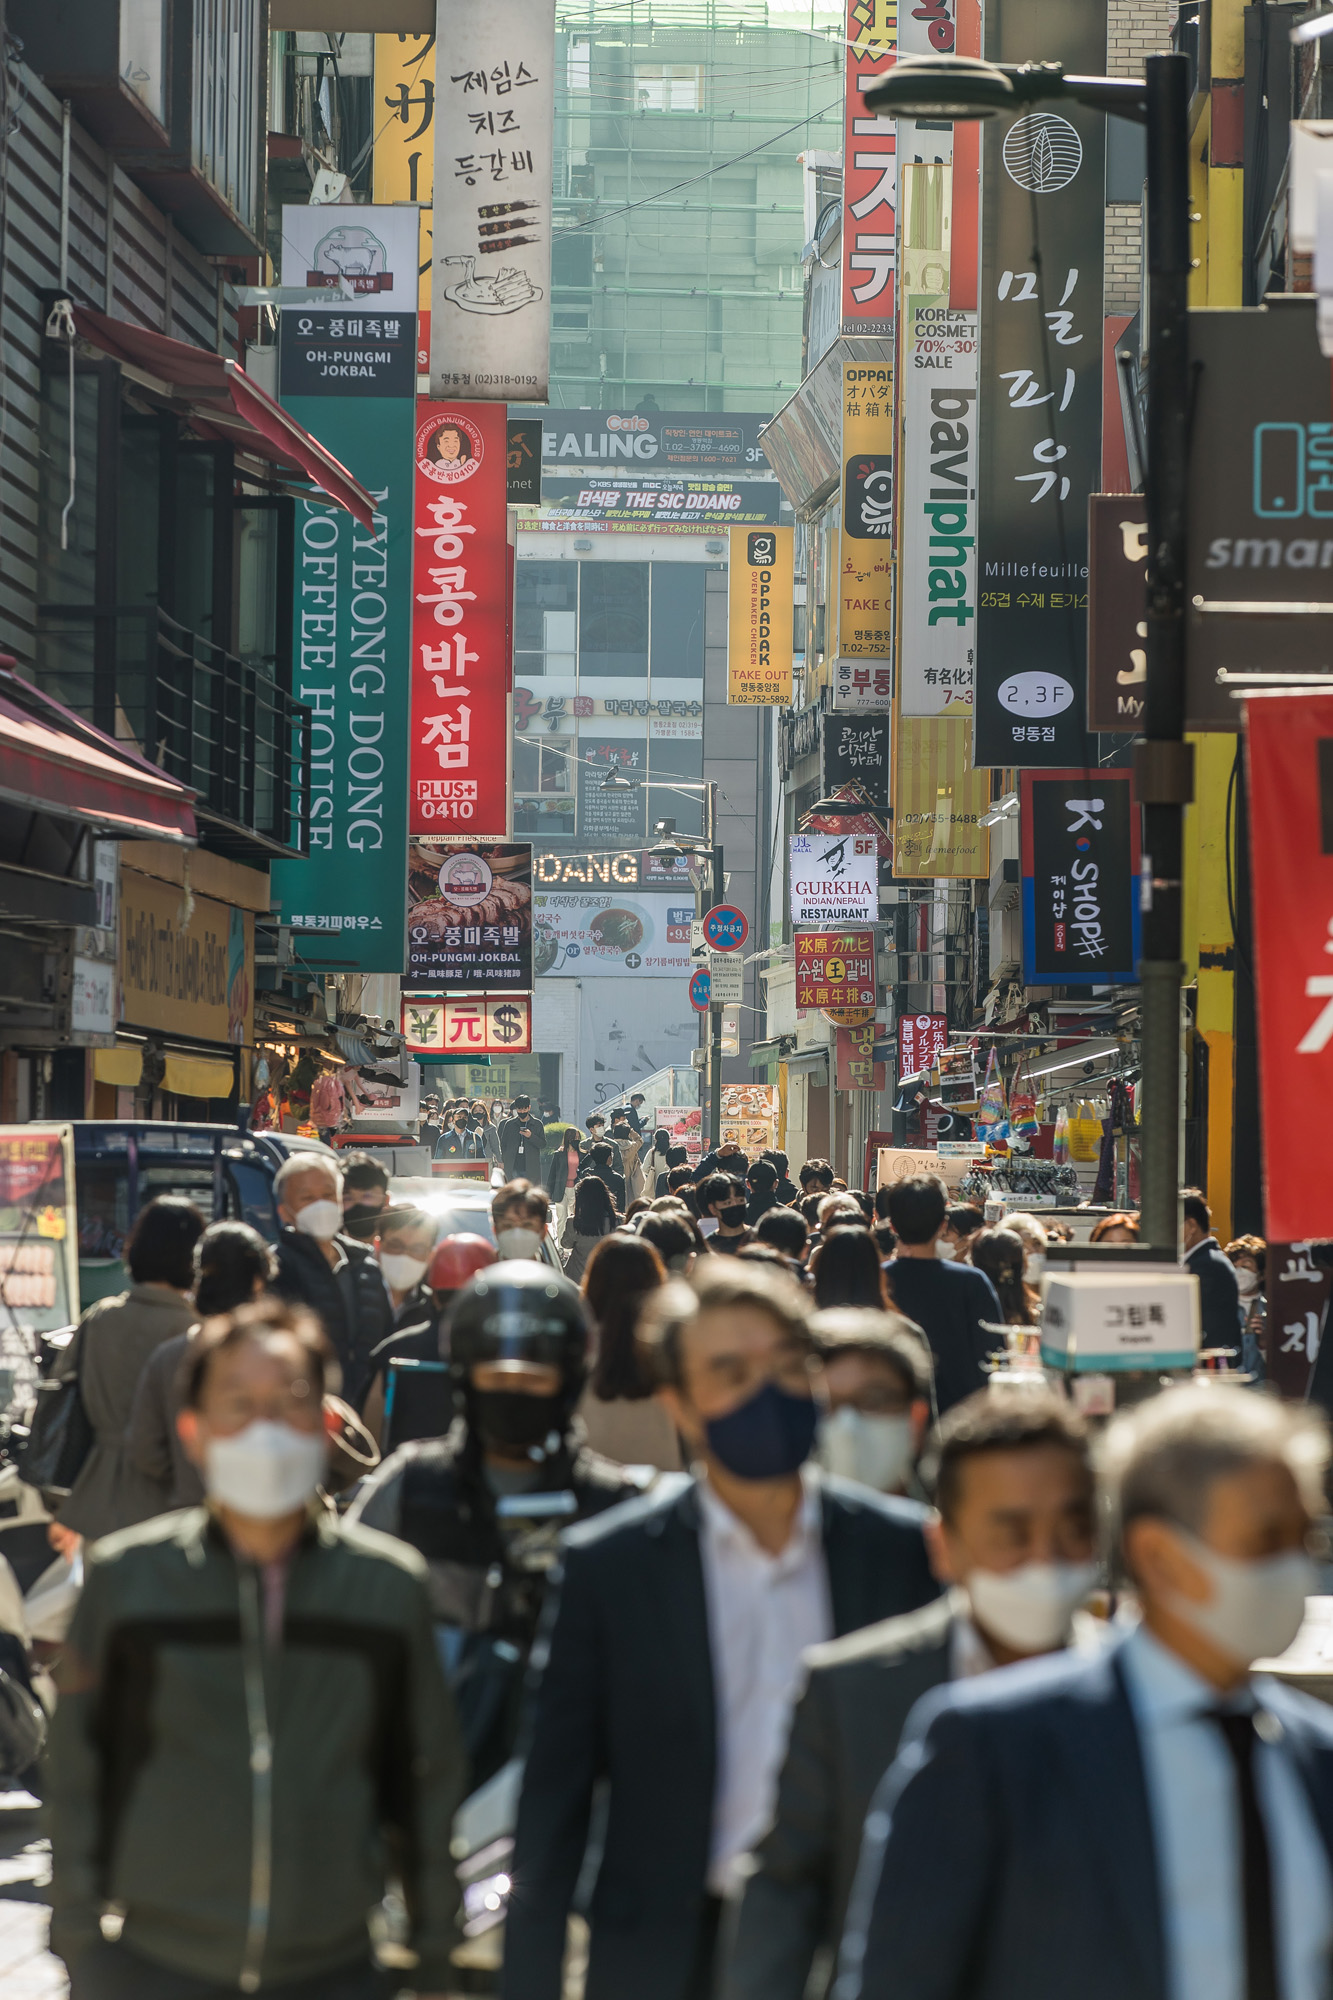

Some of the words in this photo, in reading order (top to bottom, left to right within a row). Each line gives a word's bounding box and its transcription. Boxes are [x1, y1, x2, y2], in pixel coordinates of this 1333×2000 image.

[451, 60, 539, 96] 제임스
[467, 109, 521, 136] 치즈
[454, 148, 534, 186] 등갈비
[843, 324, 855, 333] tel
[306, 350, 391, 363] OH-PUNGMI
[914, 356, 952, 368] SALE
[320, 365, 376, 377] JOKBAL
[441, 373, 470, 385] 명동점
[474, 374, 537, 385] (02)318-0192
[607, 415, 649, 431] Cafe
[417, 421, 438, 458] HONGKONG
[437, 416, 466, 427] BANJUM
[465, 423, 478, 439] 0410
[473, 439, 481, 458] PLUS
[700, 455, 737, 463] 1600-7621
[745, 447, 764, 462] 3F
[577, 490, 621, 507] 더식당
[626, 492, 658, 508] THE
[657, 493, 685, 509] SIC
[685, 494, 741, 510] DDANG
[924, 389, 976, 626] baviphat
[986, 561, 1089, 578] Millefeuille
[844, 600, 879, 610] TAKE
[981, 592, 1011, 609] 25겹
[1016, 592, 1044, 609] 수제
[750, 597, 758, 625] BAKED
[758, 570, 772, 666] OPPADAK
[415, 495, 480, 769] 홍콩반점
[732, 670, 761, 680] TAKE
[764, 670, 788, 680] OUT
[740, 682, 780, 692] 명동중앙점
[731, 695, 789, 703] T.02-752-5892
[1012, 726, 1056, 742] 명동점
[850, 755, 882, 767] 카페
[347, 711, 385, 853] DONG
[419, 782, 475, 798] PLUS+
[421, 802, 474, 818] 0410
[1065, 798, 1105, 833] K
[855, 840, 873, 854] 5F
[925, 845, 978, 857] leemeefood
[534, 854, 638, 883] DANG
[796, 881, 873, 895] GURKHA
[803, 897, 865, 905] INDIAN/NEPALI
[801, 908, 869, 919] RESTAURANT
[710, 924, 742, 933] 주정차금지
[567, 946, 580, 955] or
[799, 938, 828, 954] 水原
[411, 953, 475, 962] OH-PUNGMI
[478, 953, 521, 962] JOKBAL
[799, 988, 859, 1004] 水原牛排
[862, 992, 873, 1002] 3F
[449, 1007, 482, 1043] 元
[932, 1020, 945, 1030] 2F
[849, 1025, 876, 1088] 냉면
[470, 1068, 506, 1084] 임대
